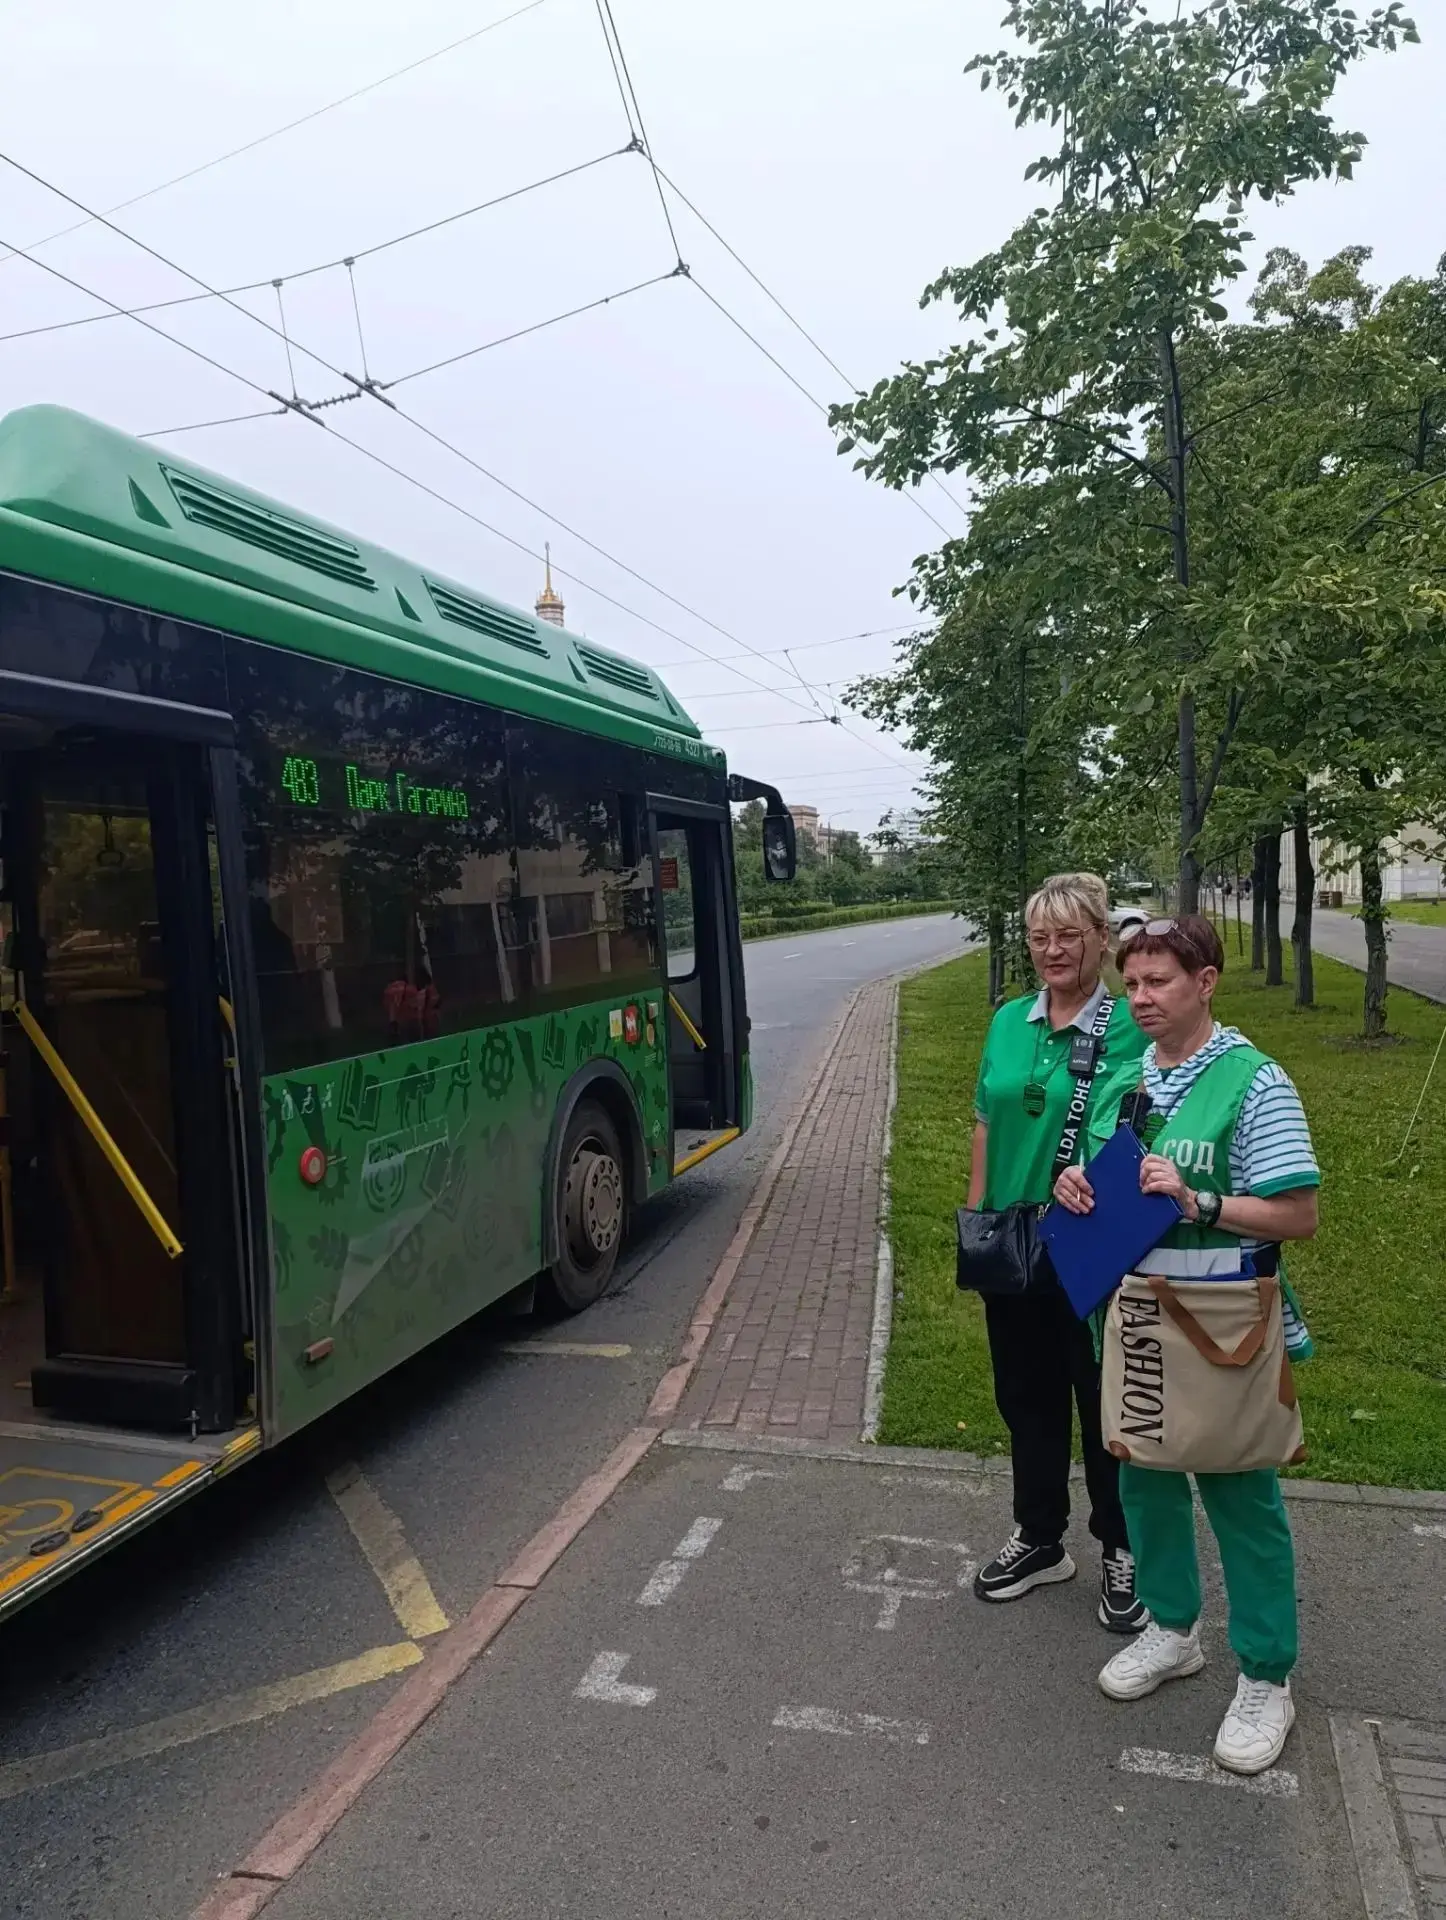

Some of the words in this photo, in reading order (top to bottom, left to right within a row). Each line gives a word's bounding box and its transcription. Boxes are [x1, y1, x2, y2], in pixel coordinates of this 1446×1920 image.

[1056, 1127, 1079, 1164] ILDA
[1162, 1138, 1215, 1176] СОД
[1119, 1292, 1164, 1444] FASHION
